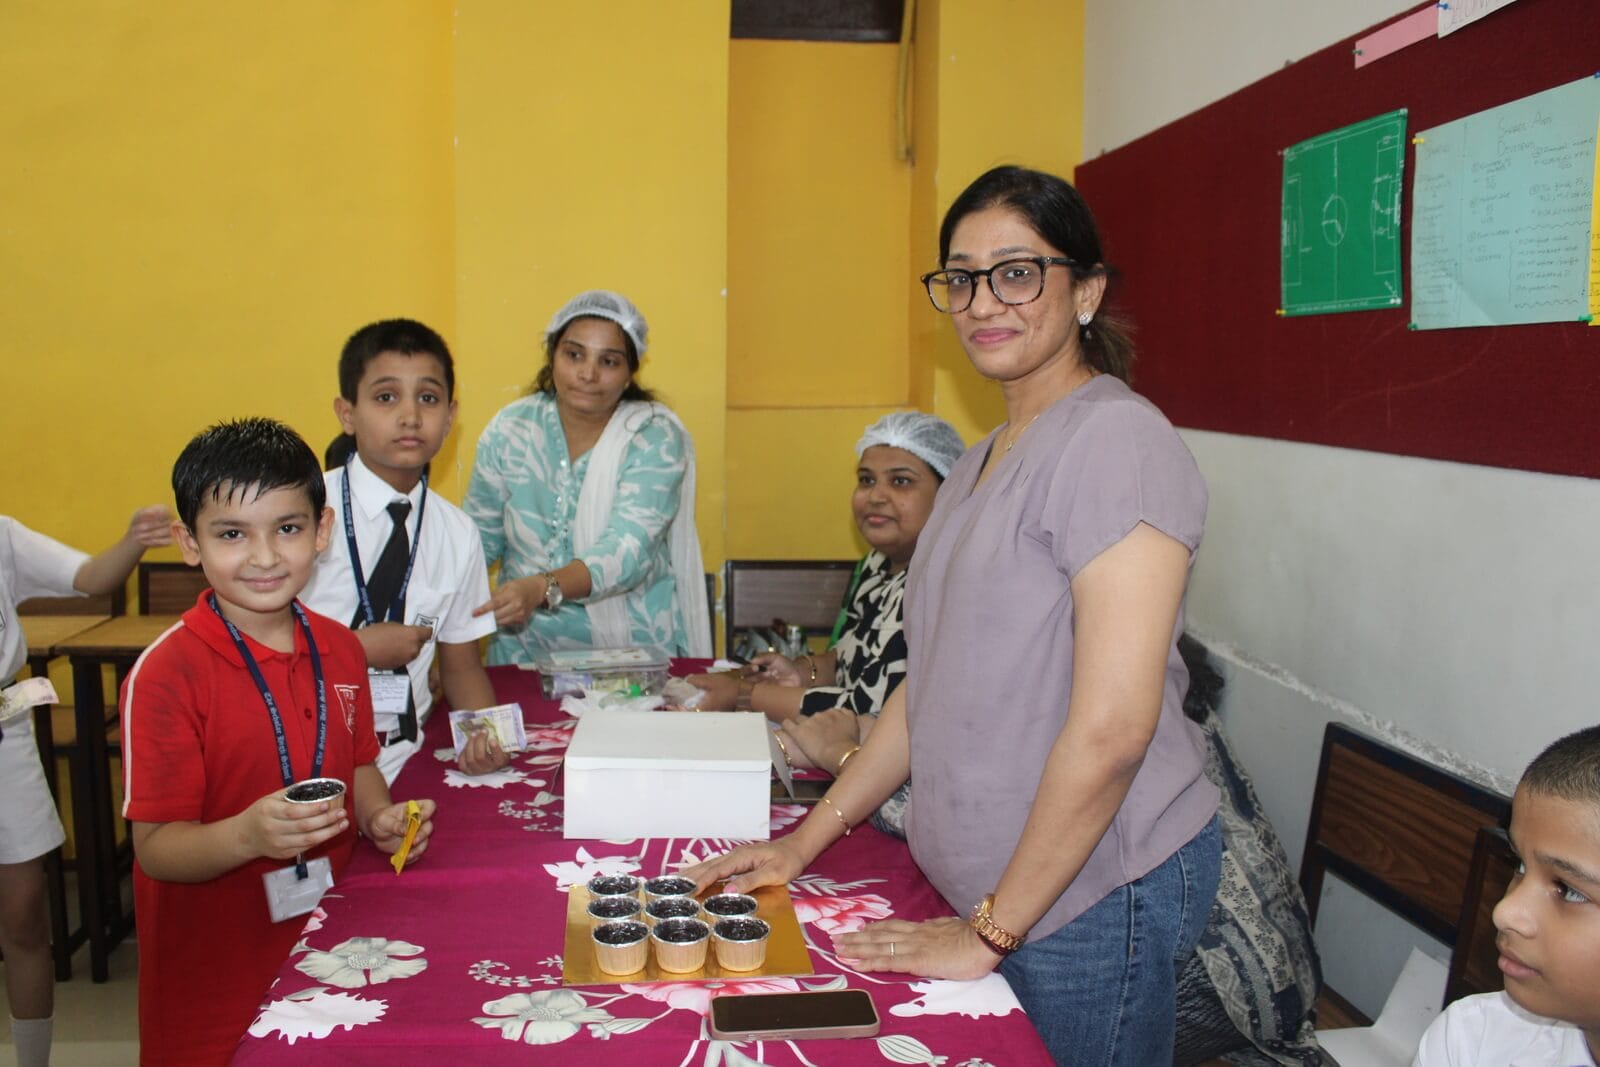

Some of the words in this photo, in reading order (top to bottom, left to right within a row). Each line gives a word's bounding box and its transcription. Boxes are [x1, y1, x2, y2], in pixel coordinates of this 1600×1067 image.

[263, 691, 275, 707] The
[317, 679, 327, 703] School
[269, 707, 283, 735] Scholar
[318, 703, 328, 722] High
[276, 735, 287, 754] High
[317, 722, 328, 751] Scholar
[280, 754, 292, 780] School
[315, 751, 325, 766] The
